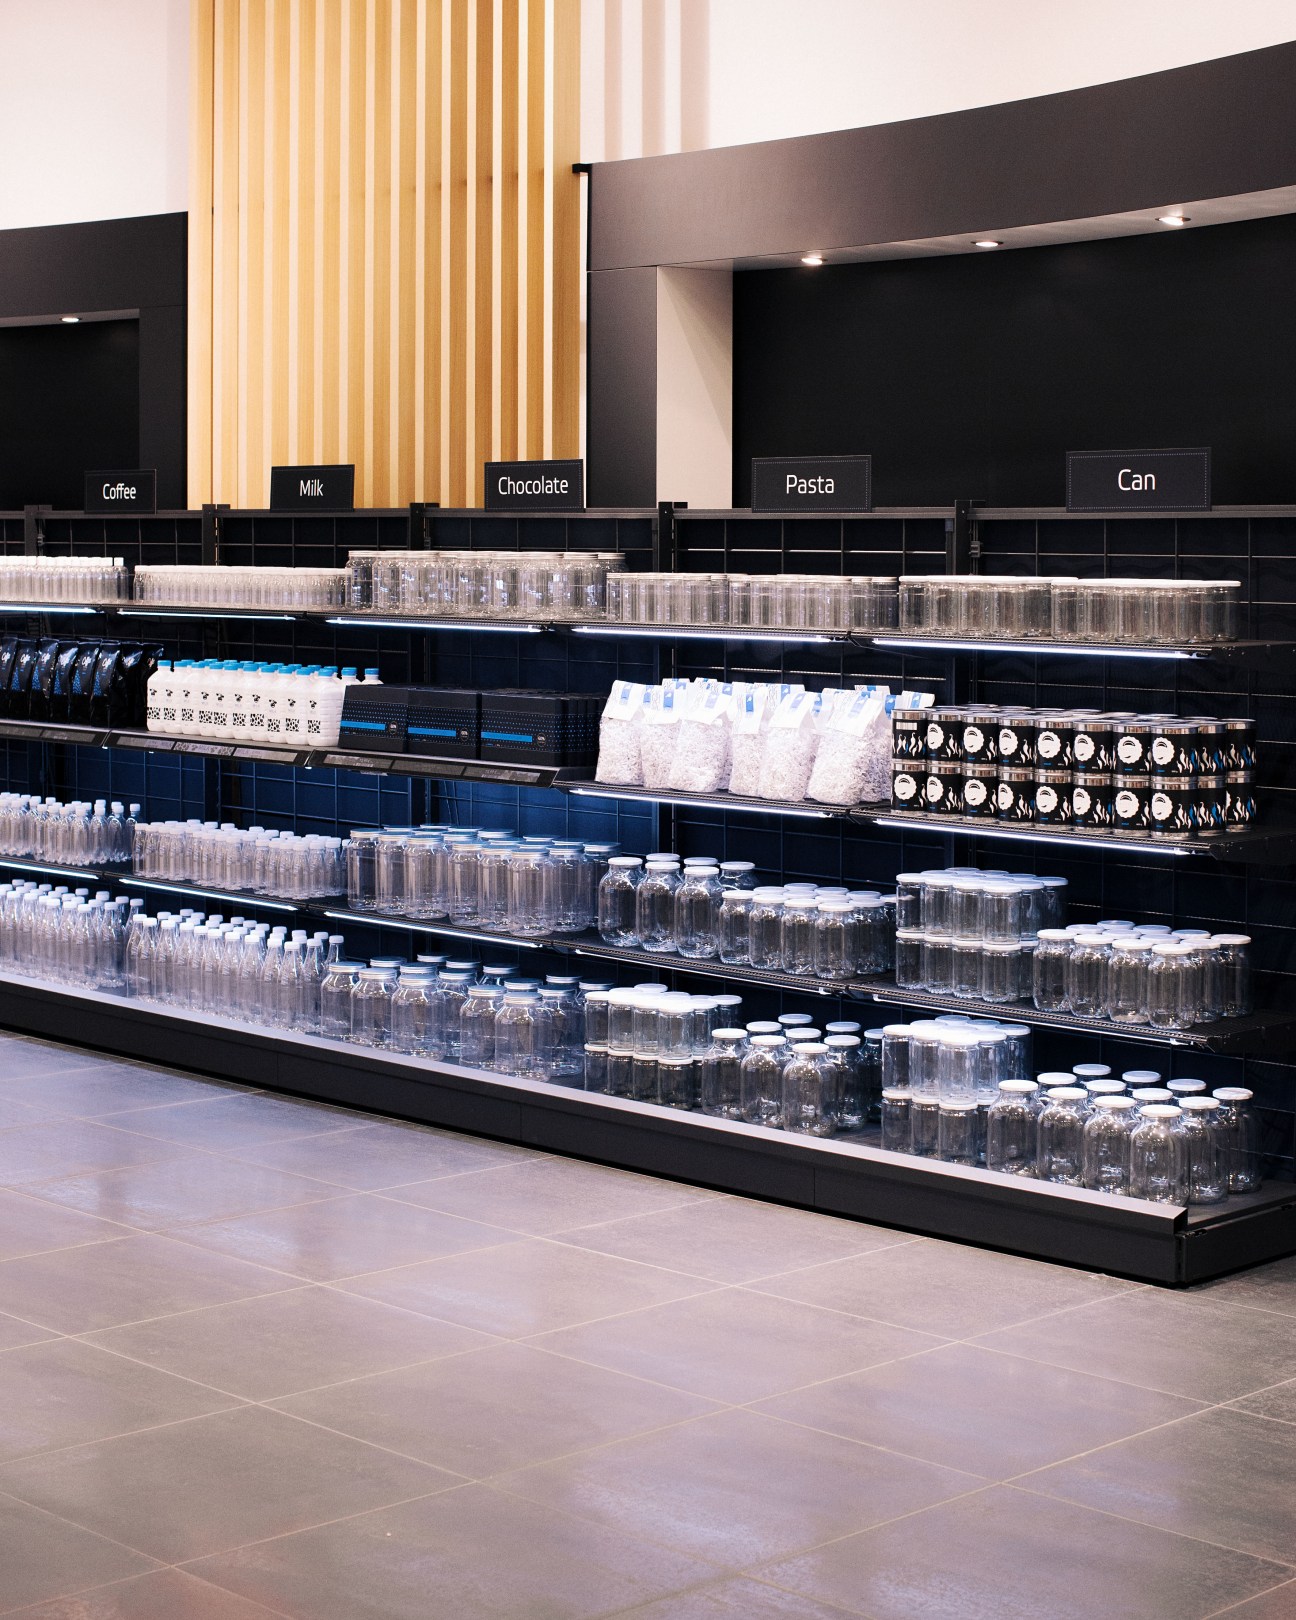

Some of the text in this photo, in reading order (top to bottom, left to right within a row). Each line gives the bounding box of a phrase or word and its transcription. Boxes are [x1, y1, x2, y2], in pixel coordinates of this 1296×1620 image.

[299, 478, 324, 497] Milk
[498, 475, 569, 496] Chocolate
[786, 474, 835, 495] Pasta
[1117, 468, 1156, 491] Can
[102, 482, 137, 500] Coffee
